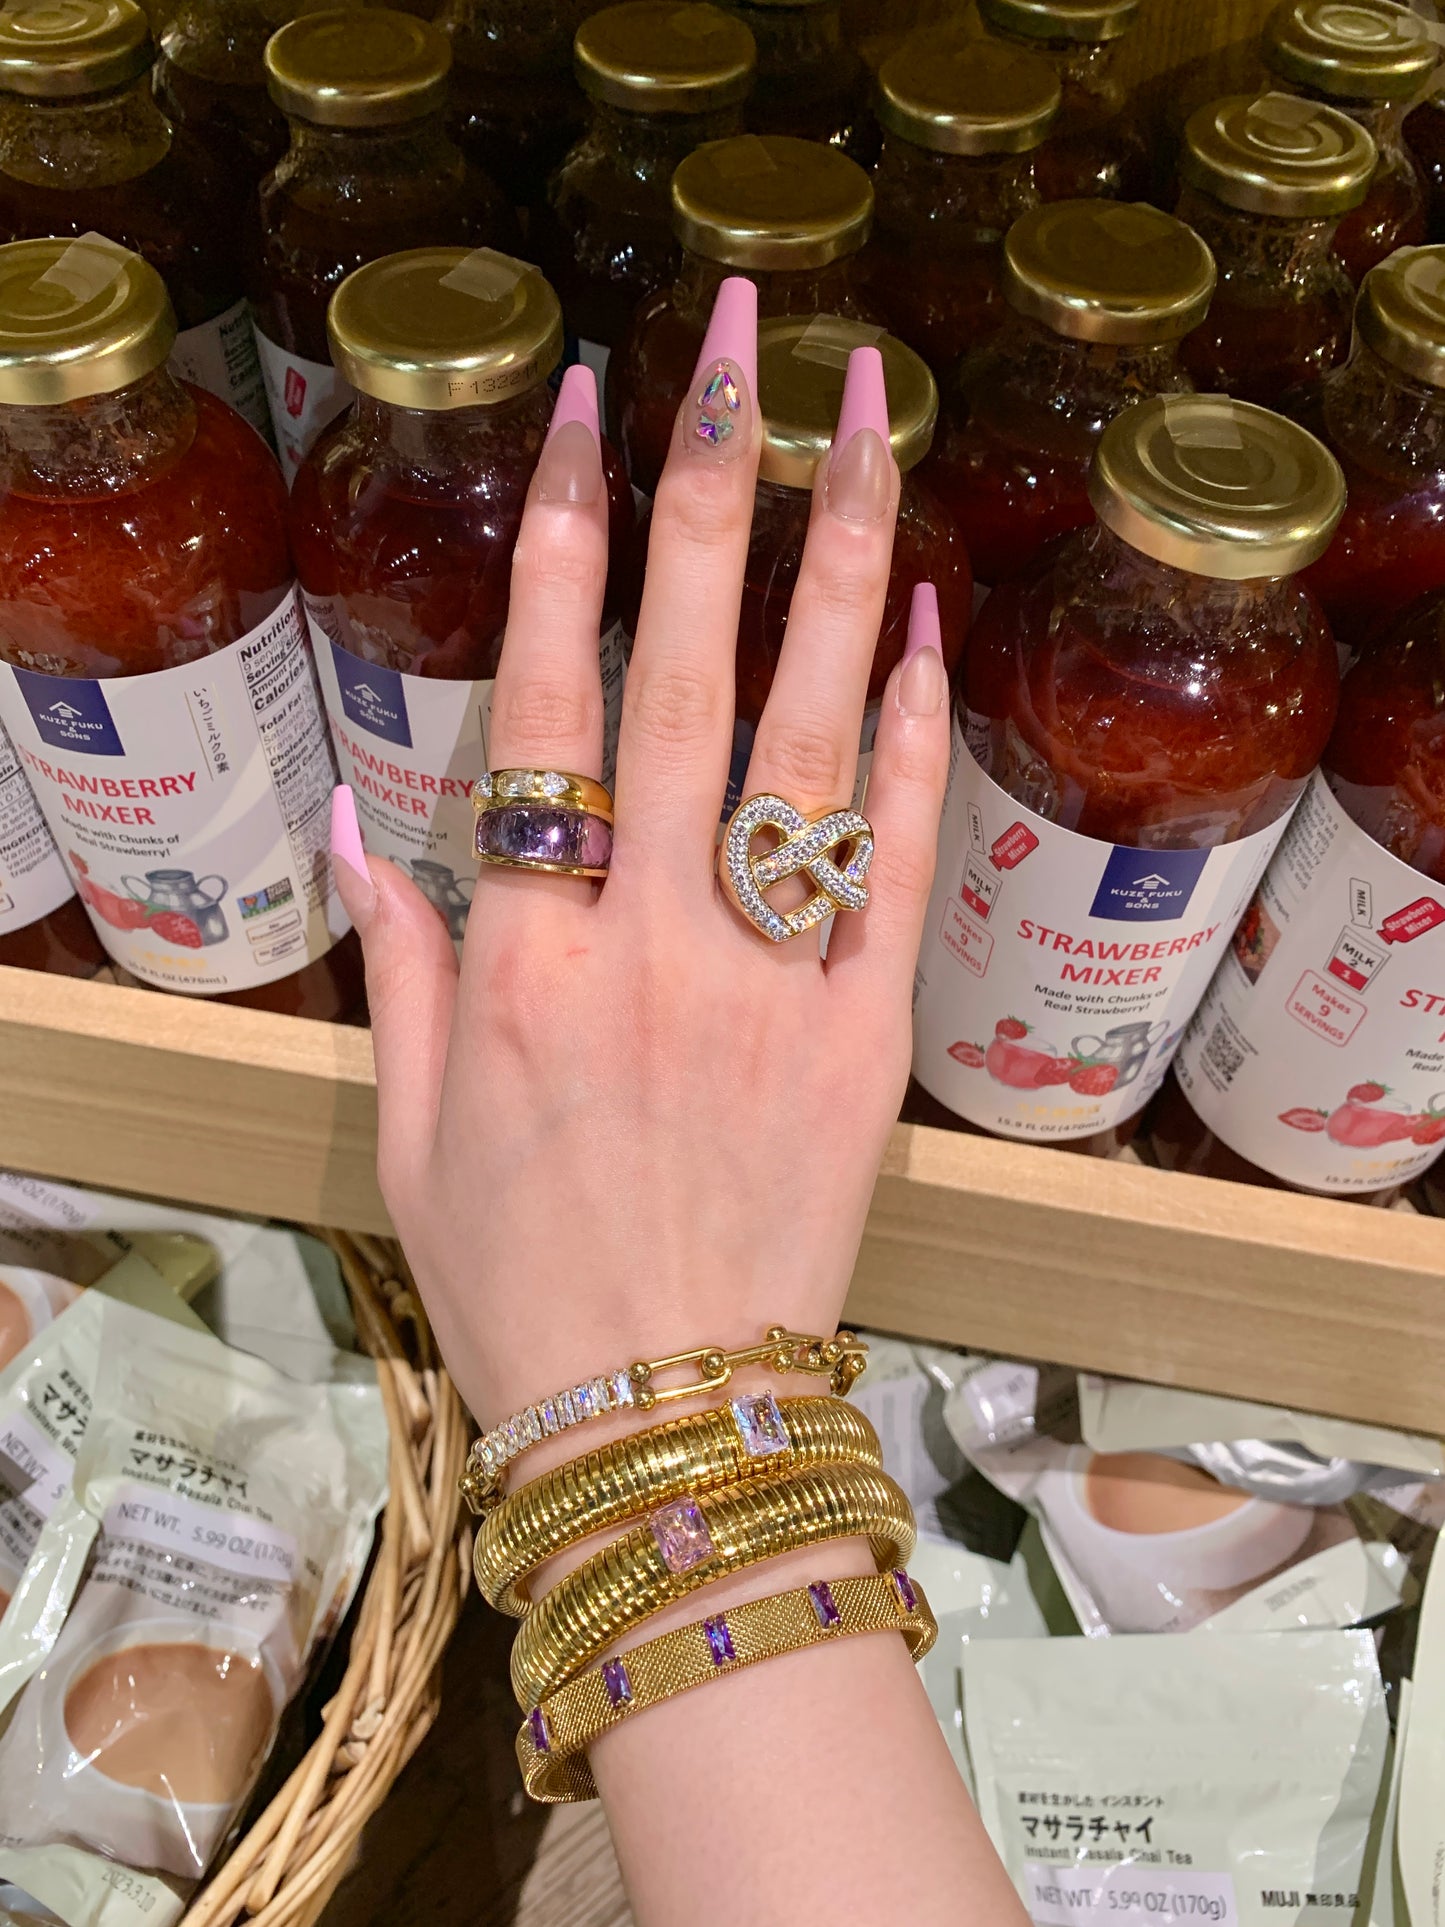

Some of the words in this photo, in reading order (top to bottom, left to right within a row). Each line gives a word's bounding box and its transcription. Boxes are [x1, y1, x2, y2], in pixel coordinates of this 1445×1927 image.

[240, 605, 296, 662] Nutrition
[254, 658, 305, 711] Calories
[39, 714, 68, 726] KUZE
[71, 721, 103, 730] FUKU
[353, 765, 429, 819] MIXER
[62, 792, 156, 825] MIXER
[119, 834, 163, 844] Chunks
[167, 834, 180, 844] of
[972, 814, 981, 841] MILK
[994, 827, 1027, 858] Strawberry
[968, 869, 993, 895] MILK
[974, 885, 982, 896] 2
[1111, 888, 1145, 898] KUZE
[1148, 890, 1183, 898] FUKU
[971, 897, 978, 909] 1
[1357, 889, 1366, 917] MILK
[1386, 902, 1435, 931] Strawberry
[953, 911, 983, 944] Makes
[960, 933, 969, 947] 9
[1017, 919, 1221, 961] STRAWBERRY
[943, 931, 982, 971] SERVINGS
[1342, 942, 1375, 968] MILK
[1349, 959, 1359, 968] 2
[1060, 963, 1162, 985] MIXER
[1341, 969, 1351, 979] 1
[1034, 984, 1071, 1001] Made
[1076, 993, 1105, 1004] with
[1108, 993, 1152, 1005] Chunks
[1155, 987, 1169, 998] of
[1044, 1000, 1072, 1013] Real
[1076, 1002, 1151, 1015] Strawberry!
[1312, 984, 1352, 1015] Makes
[1400, 989, 1445, 1016] ST
[1293, 1002, 1345, 1040] SERVINGS
[1318, 1004, 1331, 1017] 9
[129, 1448, 248, 1499] マサラチャイ
[117, 1502, 152, 1523] NET
[153, 1510, 182, 1535] WT.
[228, 1535, 255, 1557] OZ
[1021, 1815, 1154, 1844] マサラチャイ
[1166, 1849, 1193, 1865] Tea
[1035, 1885, 1062, 1906] NET
[1144, 1891, 1168, 1912] OZ
[1172, 1893, 1227, 1920] (170g)
[1261, 1890, 1300, 1908] MUJI
